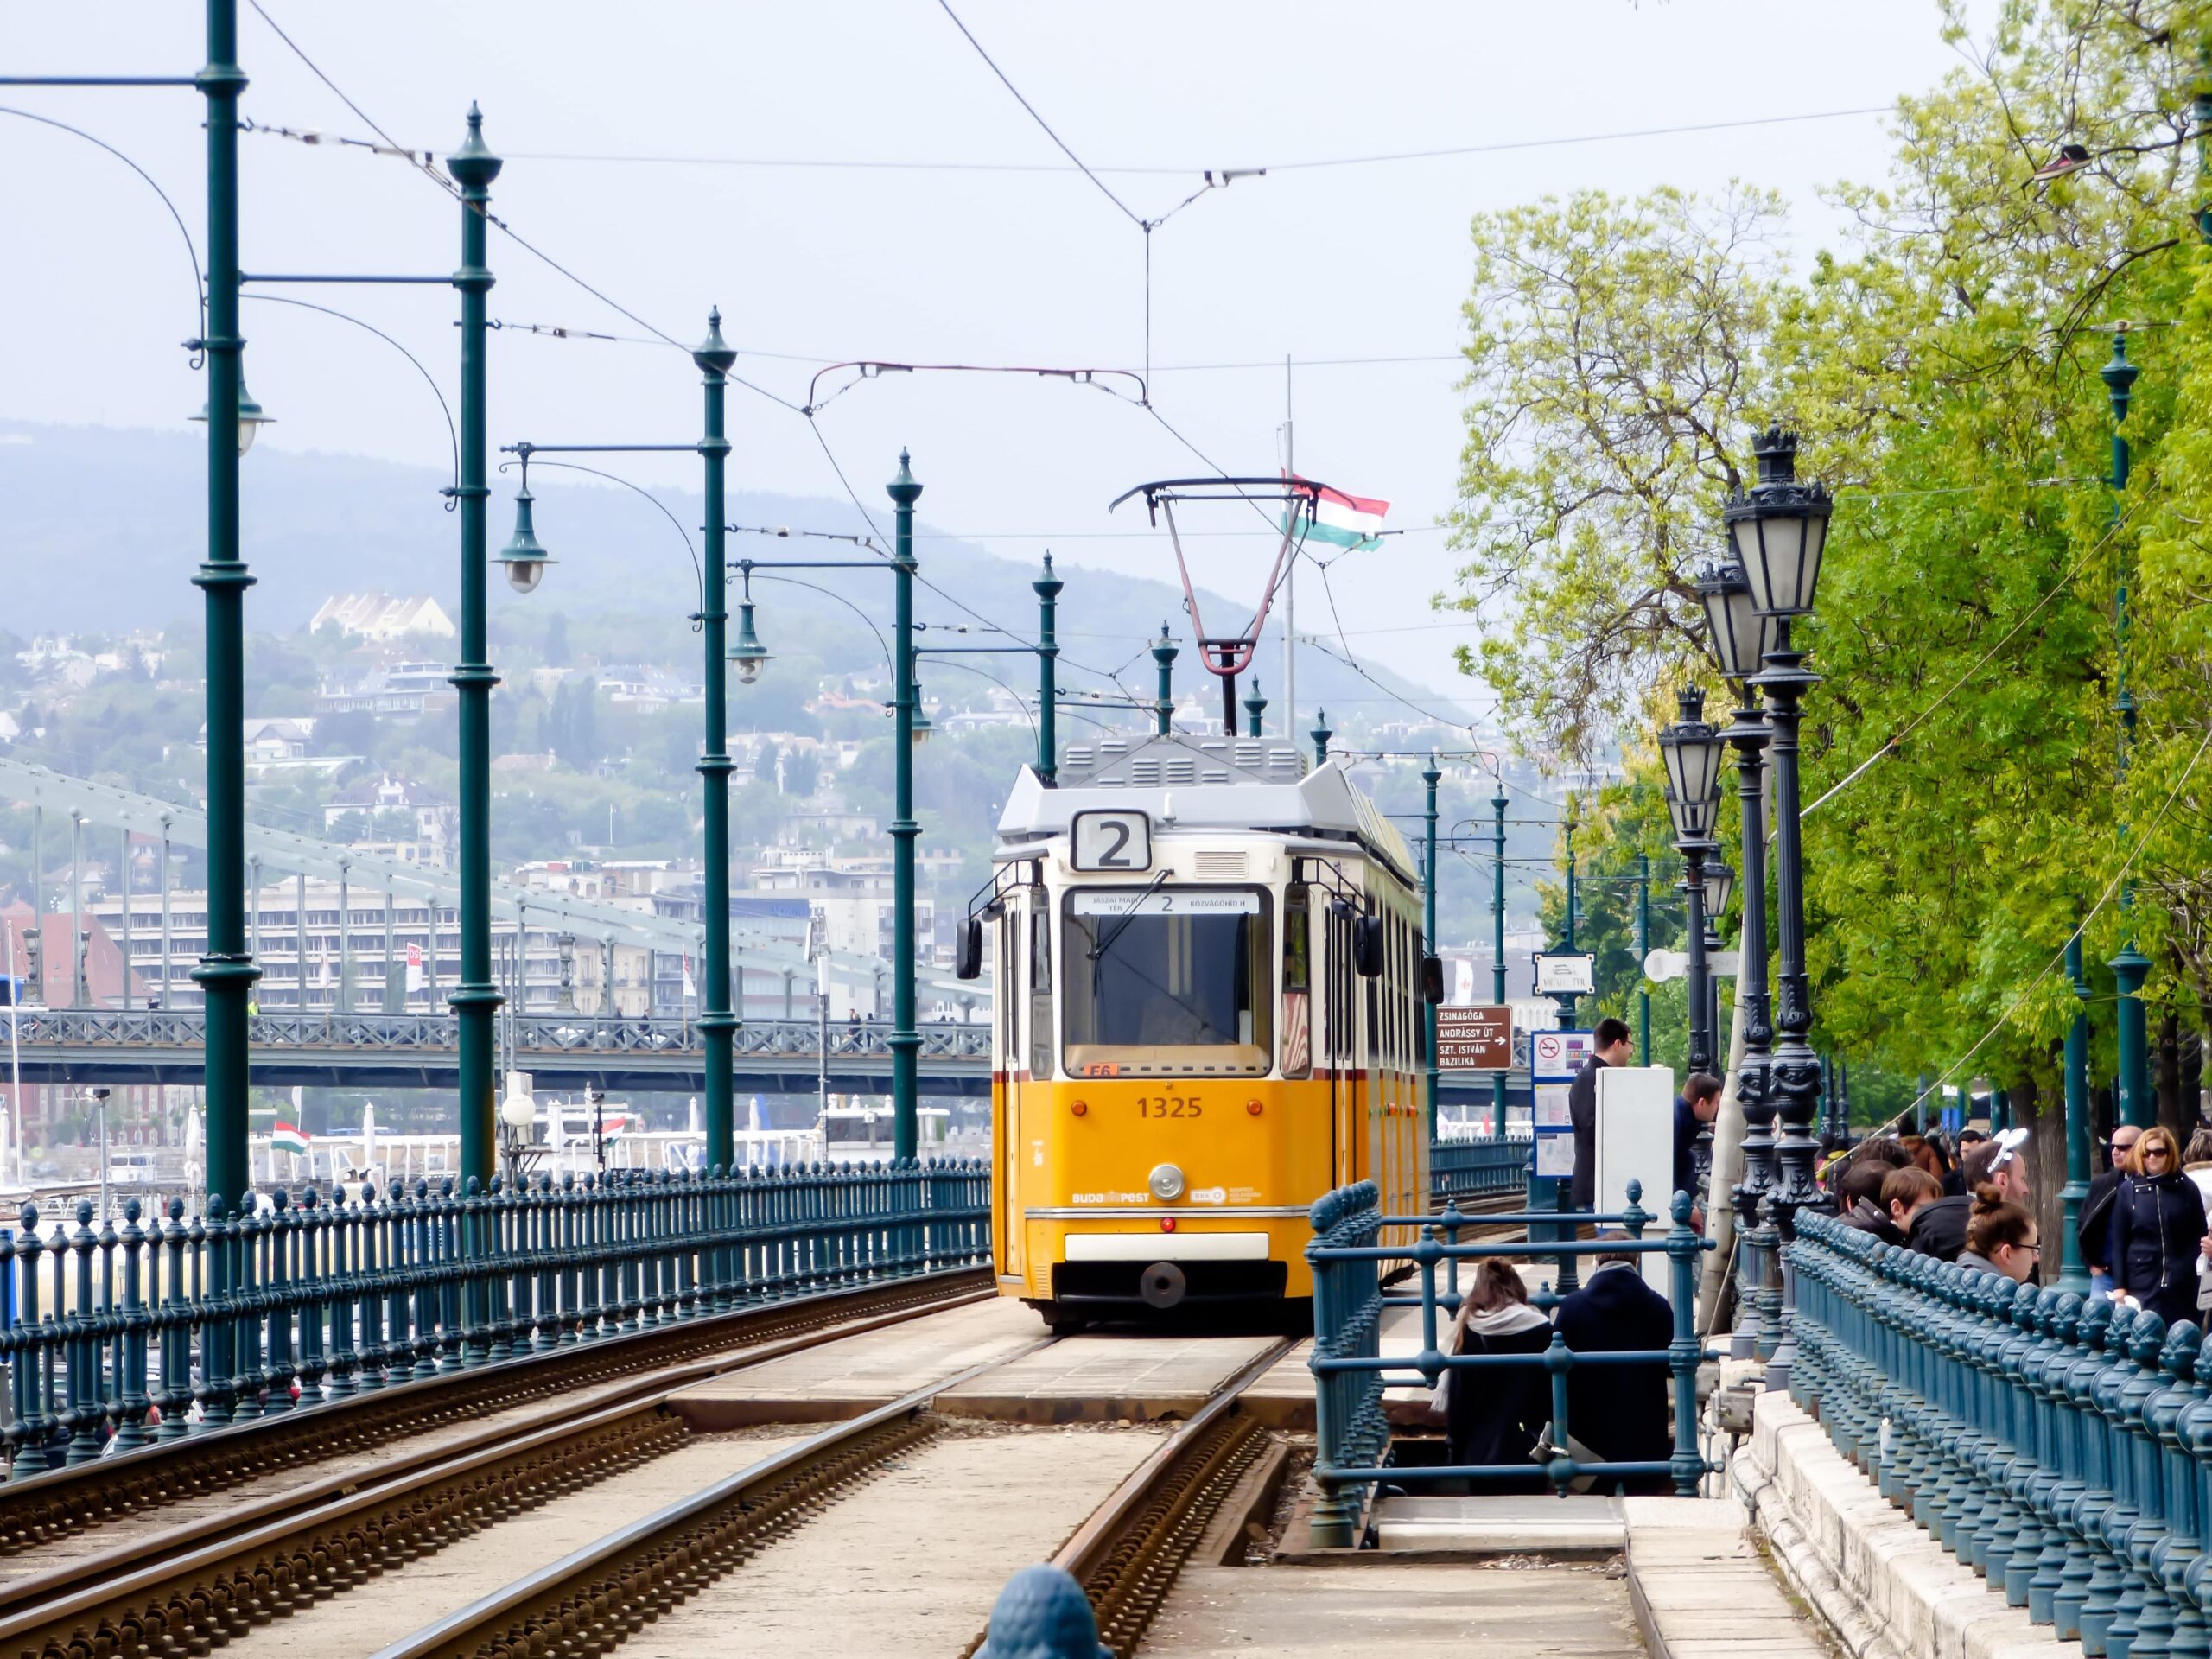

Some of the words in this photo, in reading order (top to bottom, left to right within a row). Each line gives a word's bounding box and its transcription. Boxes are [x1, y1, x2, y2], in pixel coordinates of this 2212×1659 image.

[1098, 821, 1131, 867] 2
[1161, 895, 1173, 912] 2
[1439, 1009, 1484, 1021] ZSINAGÓGA
[1440, 1027, 1481, 1038] ANDRÁSSY
[1483, 1026, 1494, 1037] ÚT
[1440, 1045, 1456, 1055] SZT.
[1459, 1043, 1486, 1054] ISTVÁN
[1440, 1057, 1475, 1066] BAZILIKA
[1136, 1097, 1203, 1118] 1325
